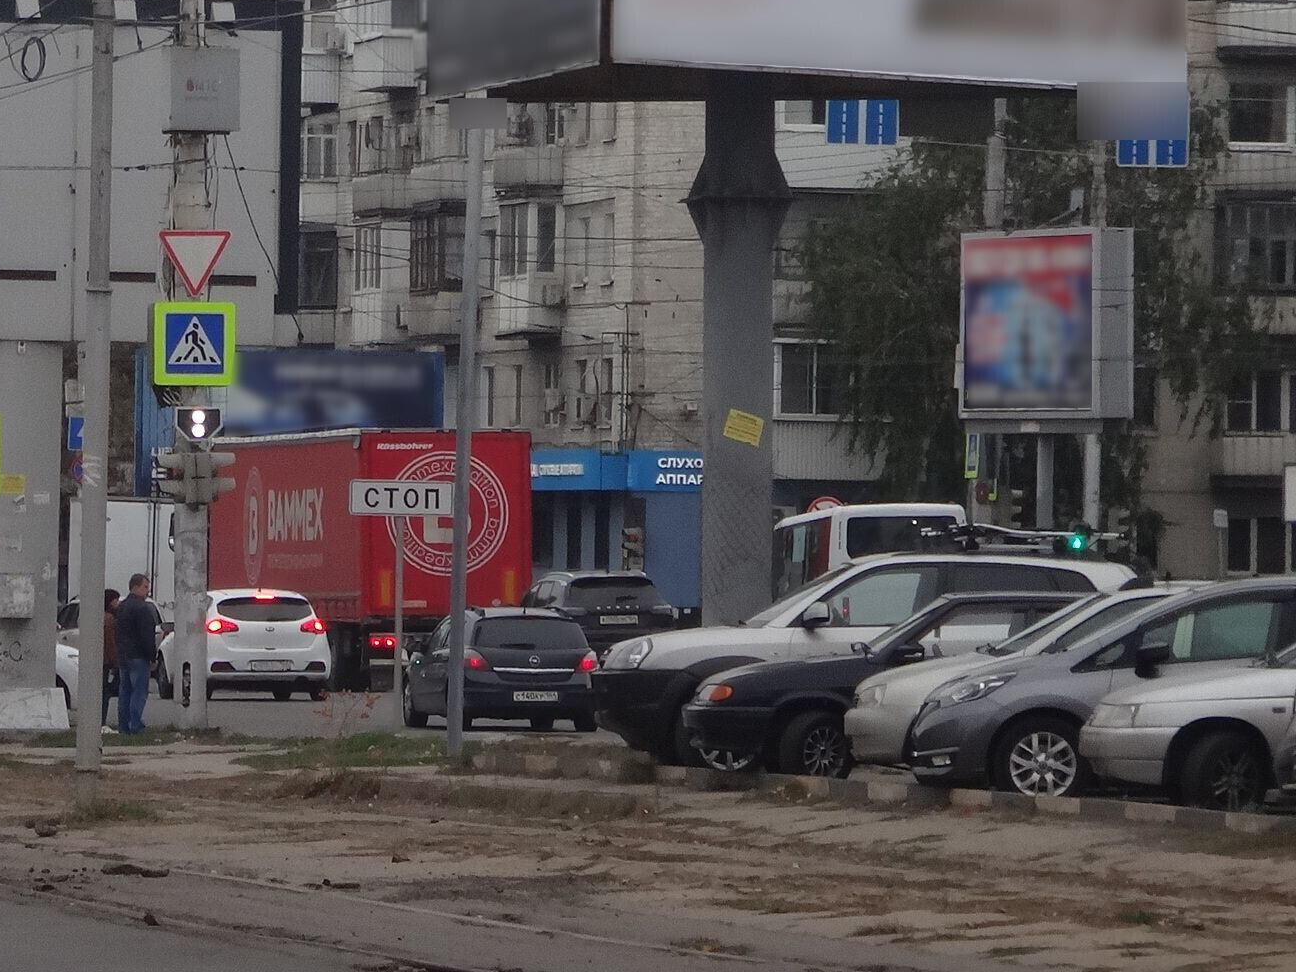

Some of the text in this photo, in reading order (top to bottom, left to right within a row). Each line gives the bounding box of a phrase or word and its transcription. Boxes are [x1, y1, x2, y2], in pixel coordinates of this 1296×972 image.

[657, 457, 704, 469] СЛУХО
[363, 487, 440, 510] СТОП
[267, 487, 324, 542] BAMMEX
